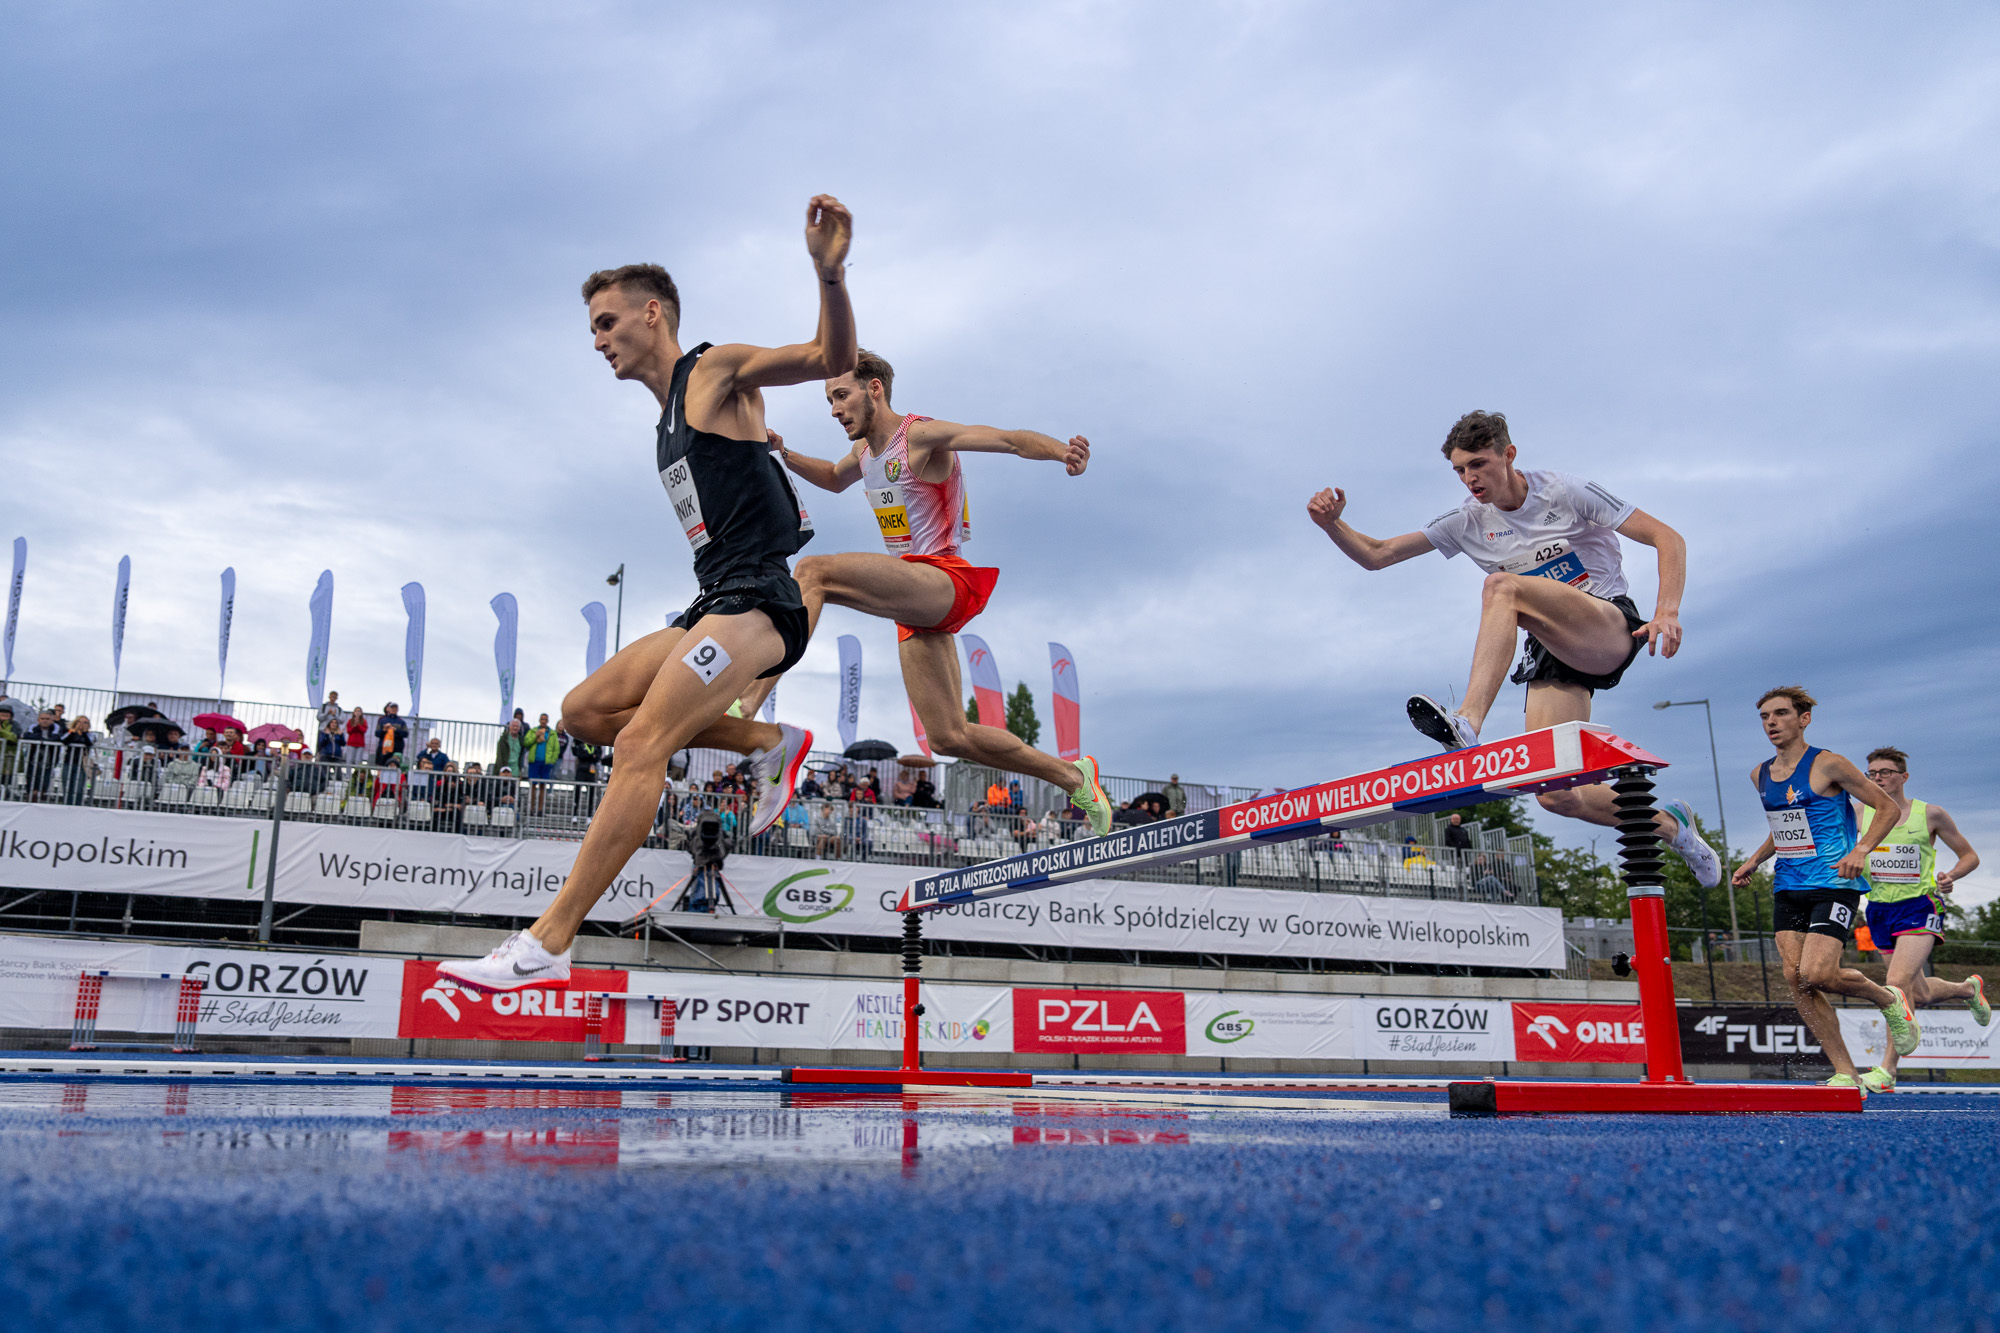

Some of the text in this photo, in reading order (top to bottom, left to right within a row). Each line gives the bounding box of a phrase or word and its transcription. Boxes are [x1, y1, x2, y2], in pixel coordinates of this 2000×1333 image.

[669, 464, 687, 488] 580
[881, 491, 894, 504] 30
[1535, 543, 1563, 561] 425
[1231, 744, 1530, 832] GORZÓW WIELKOPOLSKI 2023
[1782, 812, 1802, 822] 294
[1774, 829, 1807, 841] ANTOSZ
[925, 820, 1204, 897] 99. PZLA MISTRZOSTWA POLSKI W LEKKIEJ ATLETYCE
[1896, 846, 1915, 854] 506
[1871, 859, 1918, 868] KOŁODZIEJ
[319, 852, 654, 902] Wspieramy najleych
[786, 889, 832, 903] GBS
[880, 890, 1530, 948] Gpodarczy Bank Spółdzielczy w Gorzowie Wielkopolskim
[1836, 906, 1848, 923] 8
[1929, 917, 1941, 930] 10
[185, 959, 369, 996] GORZÓW
[717, 1000, 811, 1025] SPORT
[857, 994, 903, 1014] NESTLÉ
[198, 1000, 342, 1031] #StądJestem
[1039, 999, 1162, 1032] PZLA
[1377, 1003, 1488, 1030] GORZÓW
[939, 1021, 969, 1040] KIDS
[1217, 1023, 1242, 1031] GBS
[1694, 1016, 1821, 1053] 4F FUEL
[1389, 1035, 1477, 1057] #StądJestem
[1941, 1038, 1989, 1049] Turystyki
